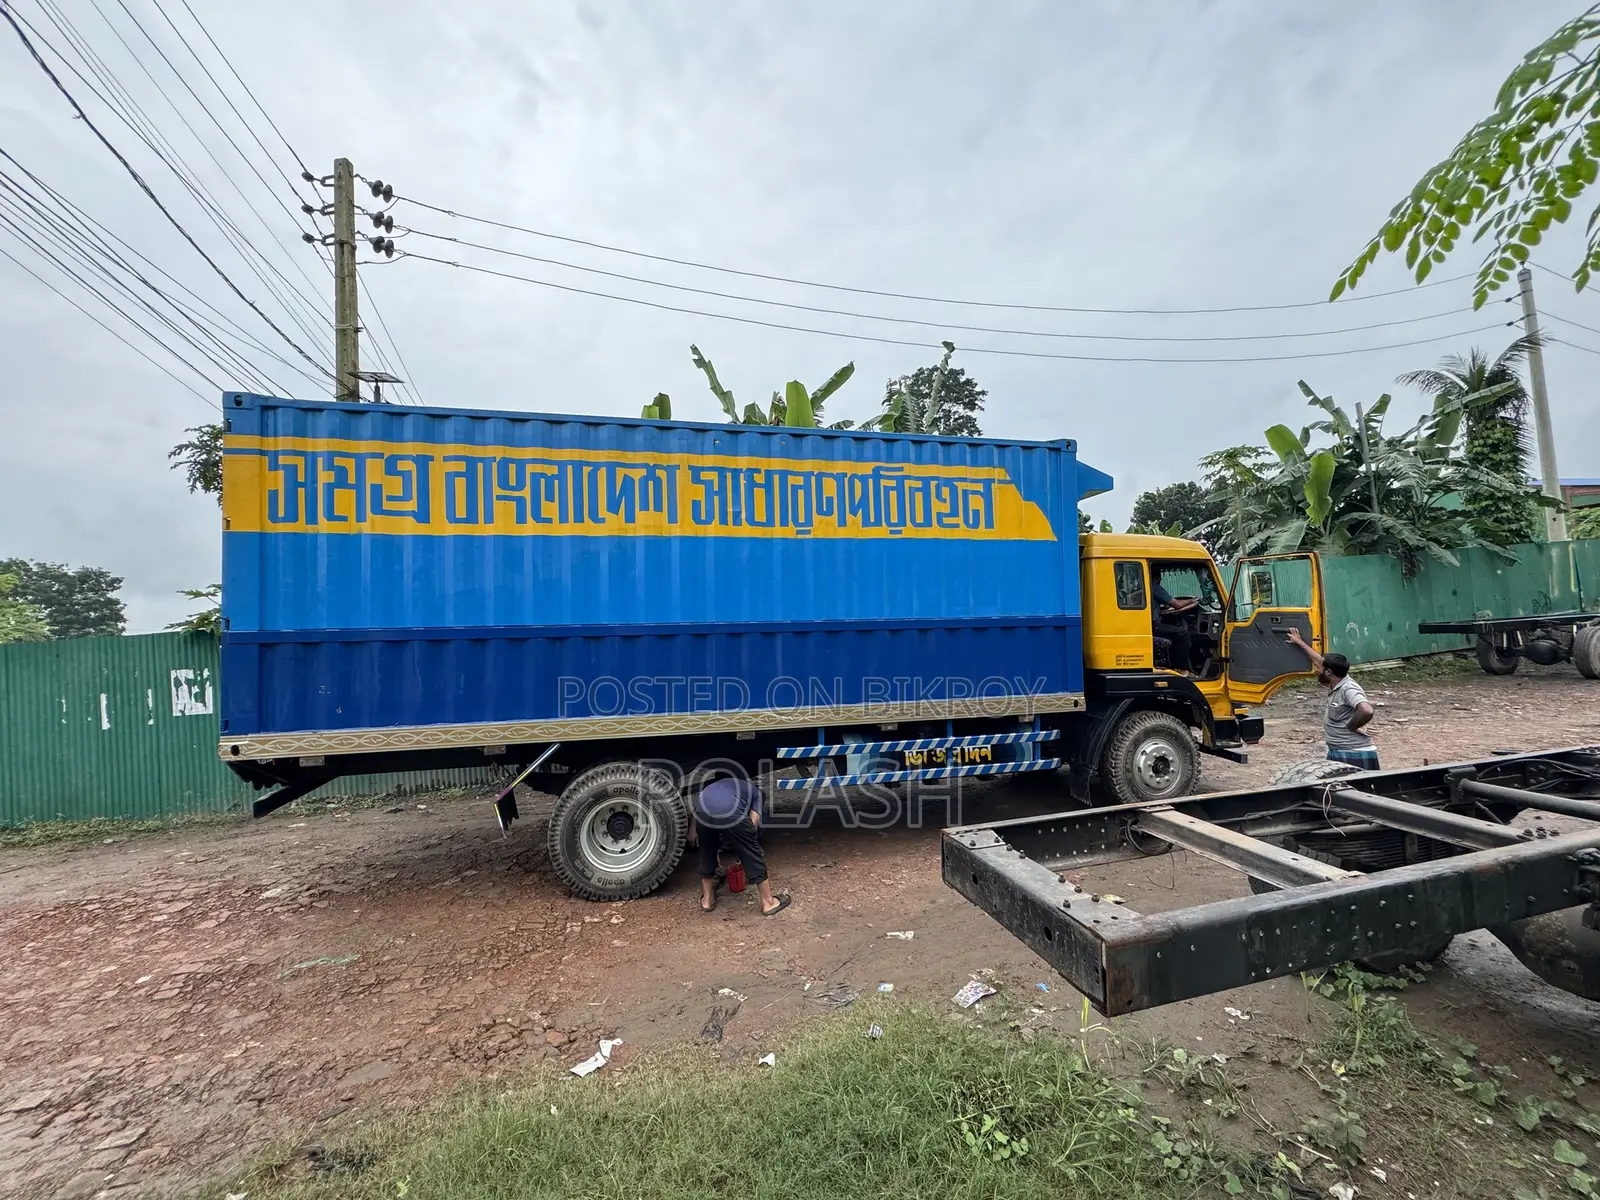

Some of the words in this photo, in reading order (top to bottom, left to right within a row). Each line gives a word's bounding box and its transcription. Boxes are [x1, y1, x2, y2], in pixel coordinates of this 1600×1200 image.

[268, 449, 434, 526] সমগ্র
[443, 454, 680, 525] বাংলাদেশ
[612, 785, 641, 796] apollo
